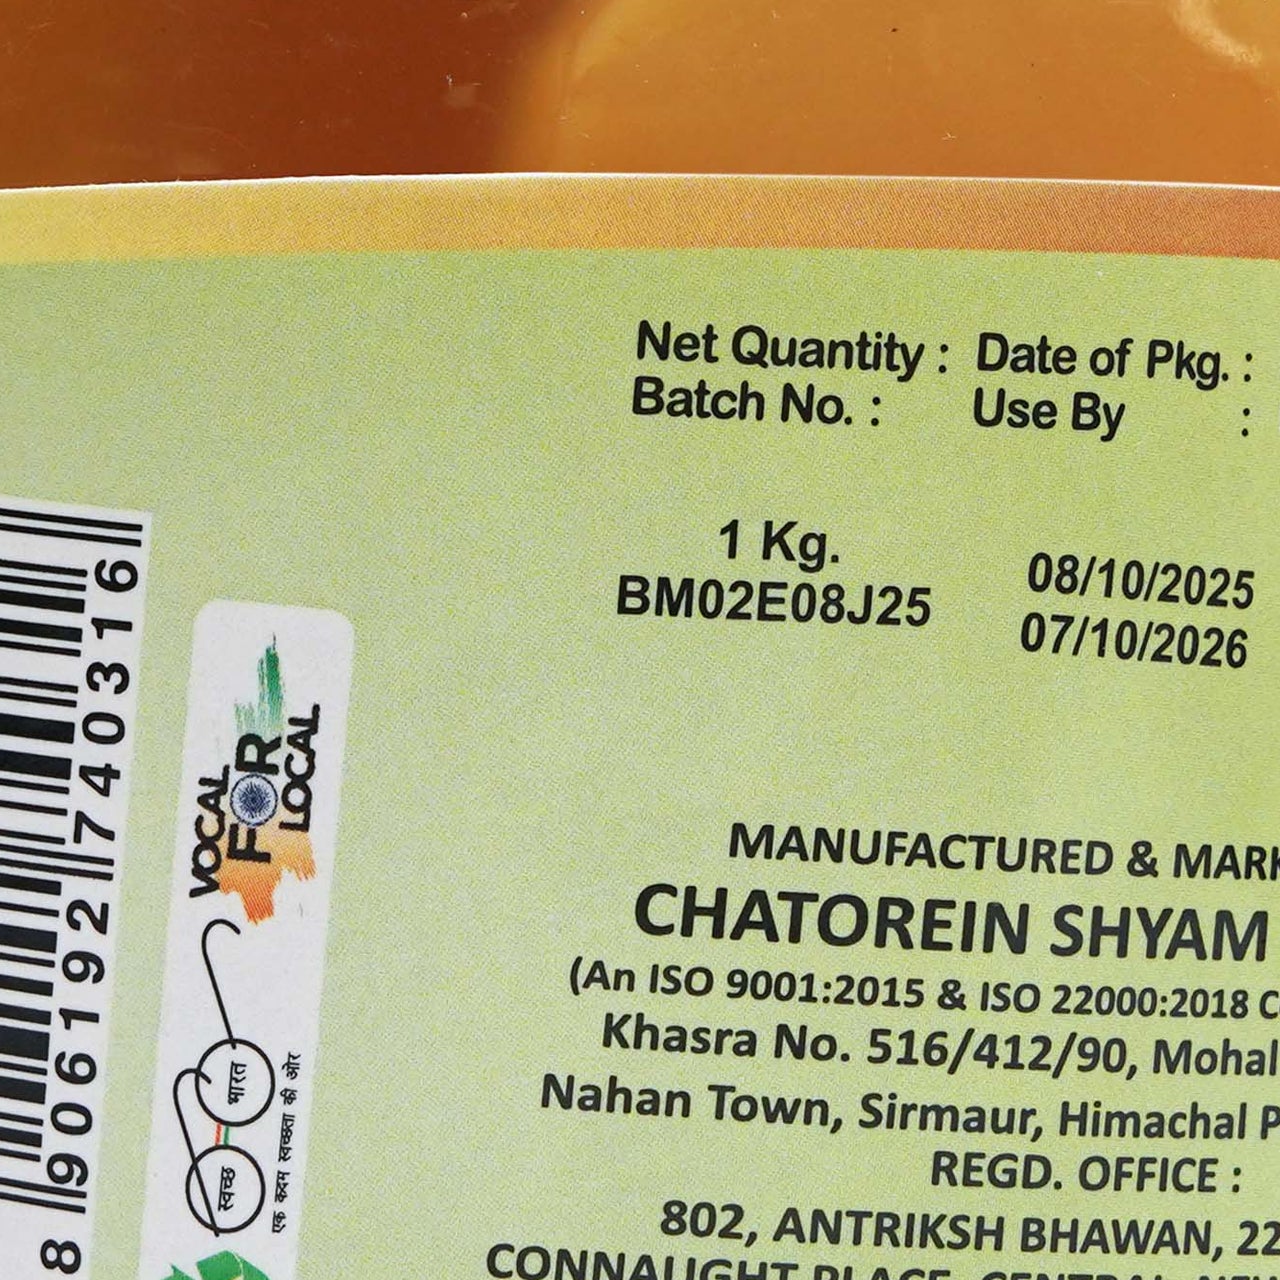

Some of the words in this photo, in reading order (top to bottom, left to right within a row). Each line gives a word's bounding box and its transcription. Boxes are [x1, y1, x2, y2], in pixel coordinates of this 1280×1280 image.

[636, 319, 720, 364] Net
[731, 324, 926, 383] Quantity
[976, 331, 1078, 376] Date
[1089, 337, 1134, 378] of
[1146, 339, 1229, 392] Pkg.
[631, 375, 766, 422] Batch
[780, 382, 853, 426] No.
[973, 386, 1058, 430] Use
[1071, 391, 1126, 443] By
[719, 518, 739, 560] 1
[761, 520, 840, 574] Kg.
[616, 574, 931, 628] BM02E08J25
[1027, 551, 1255, 610] 08/10/2025
[1020, 611, 1249, 669] 07/10/2026
[278, 703, 321, 833] LOCAL
[189, 764, 230, 899] VOCAL
[728, 822, 1114, 876] MANUFACTURED
[1126, 840, 1159, 878] &
[634, 882, 1030, 955] CHATOREIN
[1049, 903, 1269, 962] SHYAM
[569, 955, 636, 997] (An
[649, 963, 714, 997] ISO
[726, 968, 925, 1009] 9001:2015
[936, 979, 967, 1011] &
[980, 981, 1041, 1014] ISO
[1051, 984, 1249, 1020] 22000:2018
[281, 1051, 301, 1081] ओर
[602, 1012, 758, 1058] Khasra
[773, 1023, 850, 1063] No.
[866, 1027, 1138, 1081] 516/412/90,
[1152, 1037, 1279, 1077] Mohal
[280, 1087, 298, 1105] की
[541, 1073, 691, 1119] Nahan
[707, 1084, 843, 1135] Town,
[858, 1092, 1043, 1143] Sirmaur,
[1059, 1100, 1248, 1140] Himachal
[218, 1166, 236, 1212] स्वच्छ
[227, 1060, 248, 1105] भारत
[278, 1112, 296, 1163] स्वच्छता
[274, 1170, 290, 1204] कदम
[931, 1150, 1063, 1191] REGD.
[1078, 1155, 1219, 1194] OFFICE
[271, 1210, 287, 1234] एक
[660, 1199, 758, 1248] 802,
[772, 1207, 1005, 1252] ANTRIKSH
[1020, 1217, 1223, 1263] BHAWAN,
